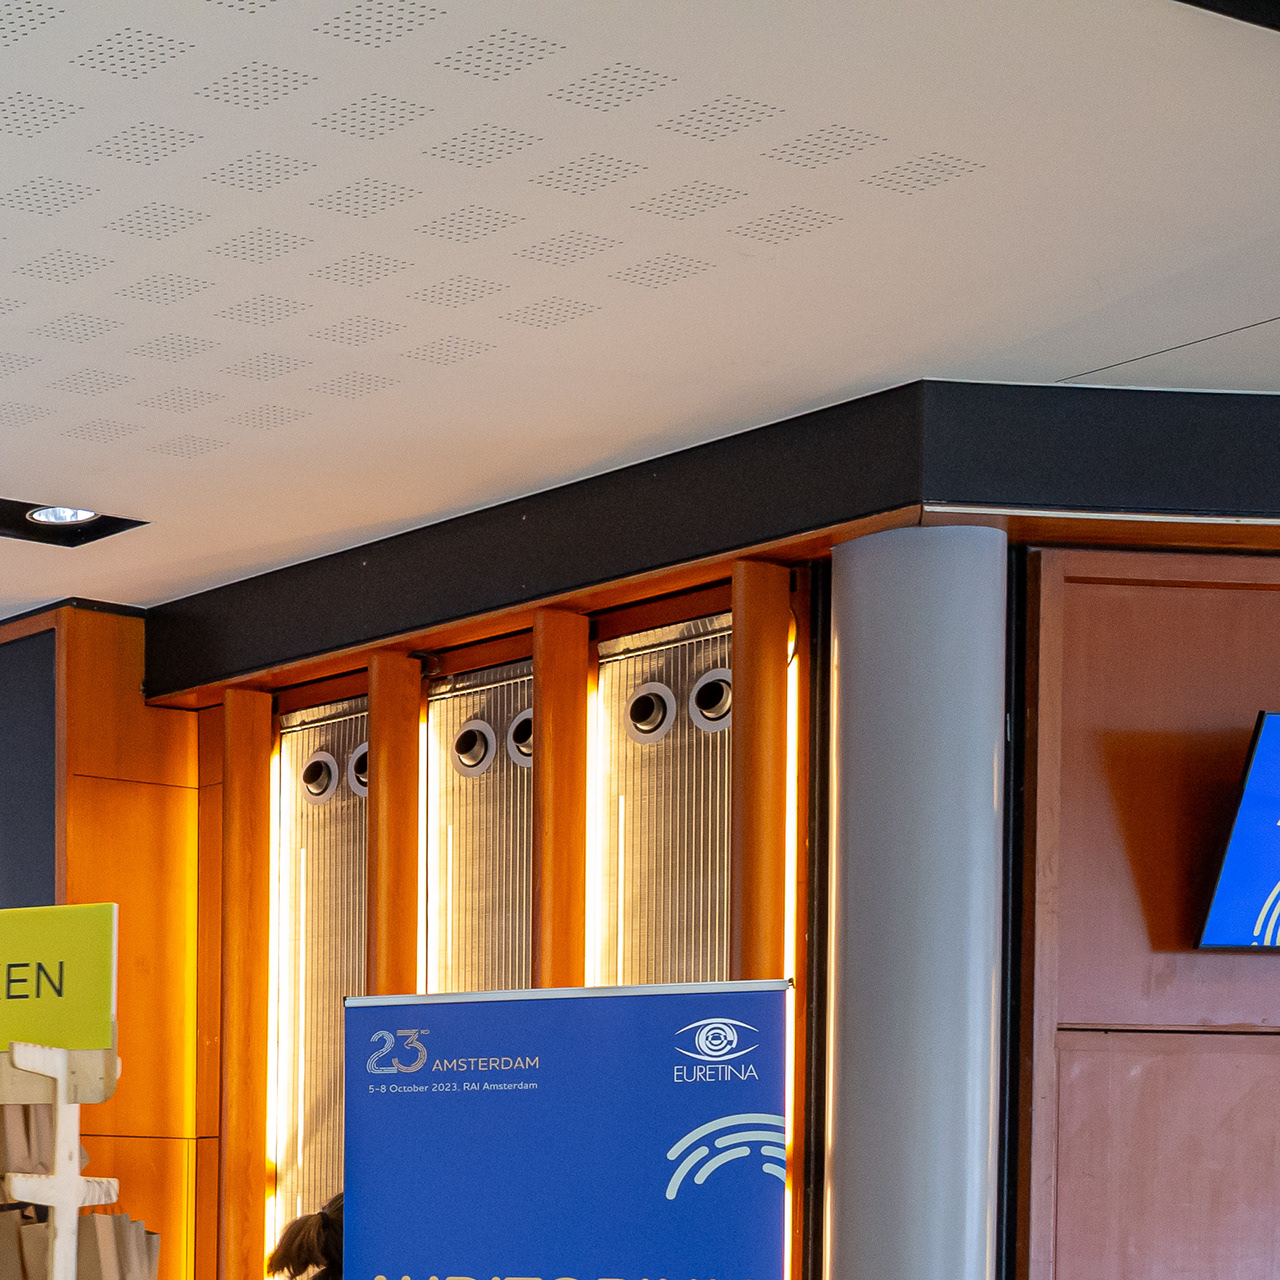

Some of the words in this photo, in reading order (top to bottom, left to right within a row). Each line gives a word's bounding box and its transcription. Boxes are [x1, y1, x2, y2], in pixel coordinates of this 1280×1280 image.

[432, 1056, 539, 1072] AMSTERDAM
[673, 1064, 759, 1083] EURETINA
[368, 1084, 387, 1094] 5-8
[389, 1083, 429, 1094] October
[463, 1082, 480, 1091] RAI
[482, 1081, 538, 1091] Amsterdam
